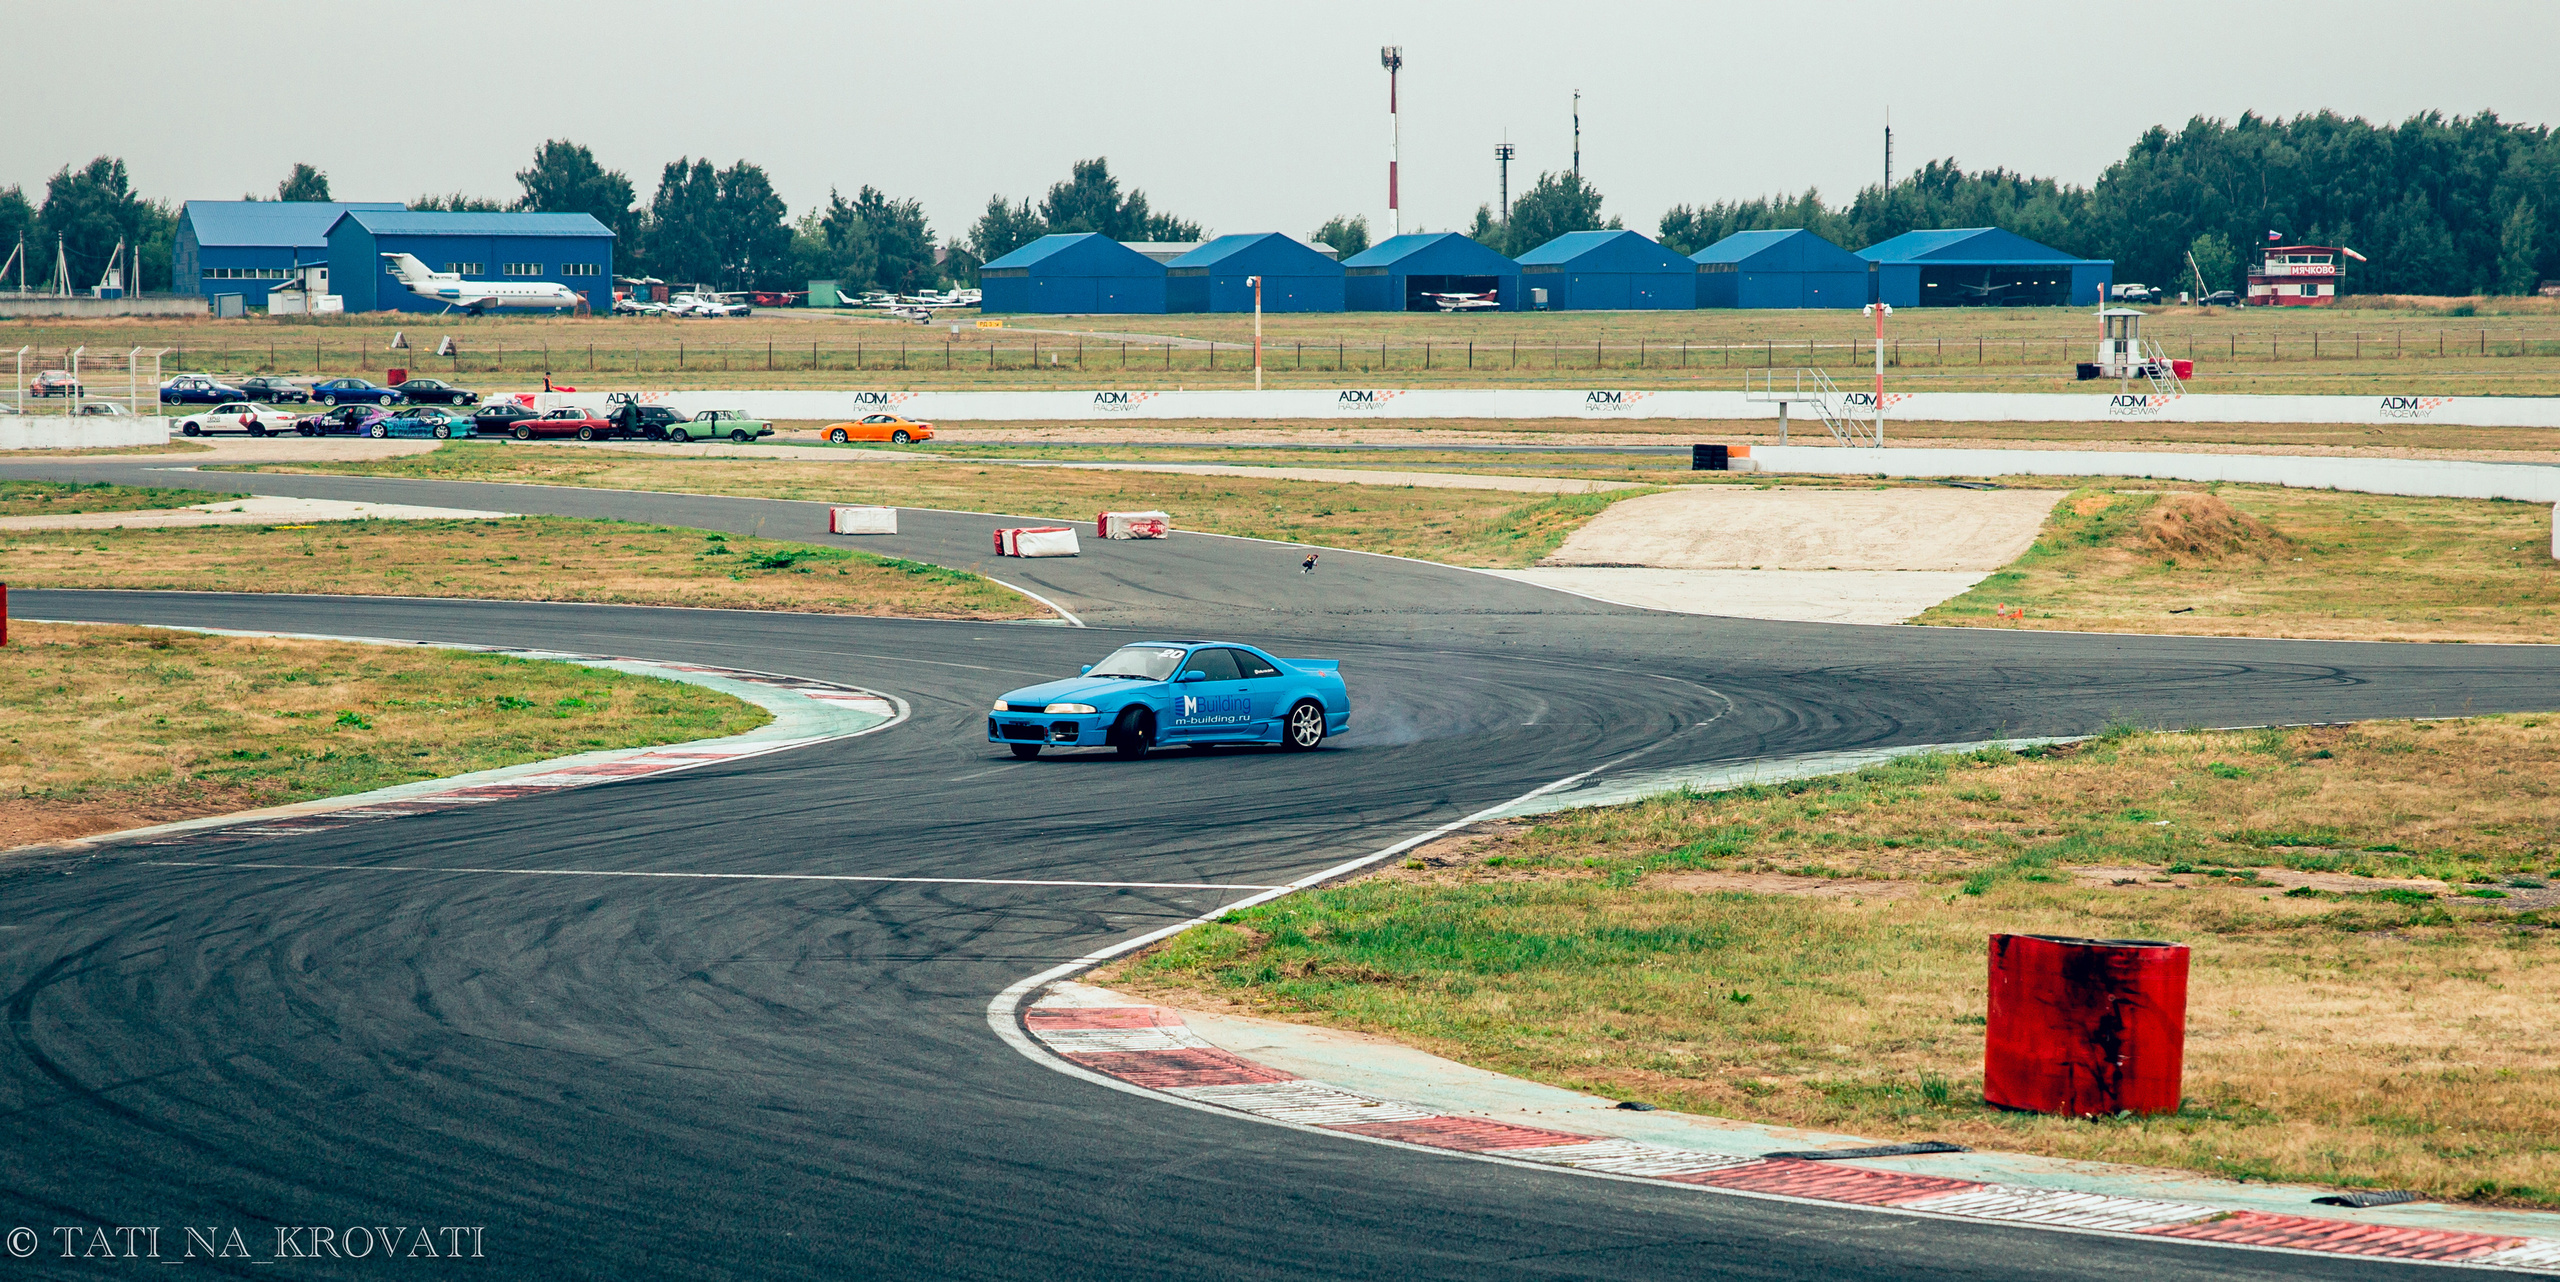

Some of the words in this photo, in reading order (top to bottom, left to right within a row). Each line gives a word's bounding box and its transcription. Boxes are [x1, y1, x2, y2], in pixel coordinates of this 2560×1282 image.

[2291, 266, 2335, 275] МЯЧКОВО
[854, 392, 888, 404] ADM
[1094, 392, 1128, 404] ADM
[1339, 390, 1373, 402] ADM
[1586, 391, 1621, 403] ADM
[1843, 393, 1877, 406] ADM
[2110, 395, 2147, 407] ADM
[853, 404, 899, 412] RACEWAY
[1093, 404, 1140, 412] RACEWAY
[1338, 402, 1386, 410] RACEWAY
[1585, 403, 1634, 411] RACEWAY
[2380, 397, 2418, 410] ADM
[2109, 407, 2160, 415] RACEWAY
[2379, 409, 2432, 418] RACEWAY
[1159, 649, 1186, 659] 20
[1175, 715, 1251, 725] m-building.ru
